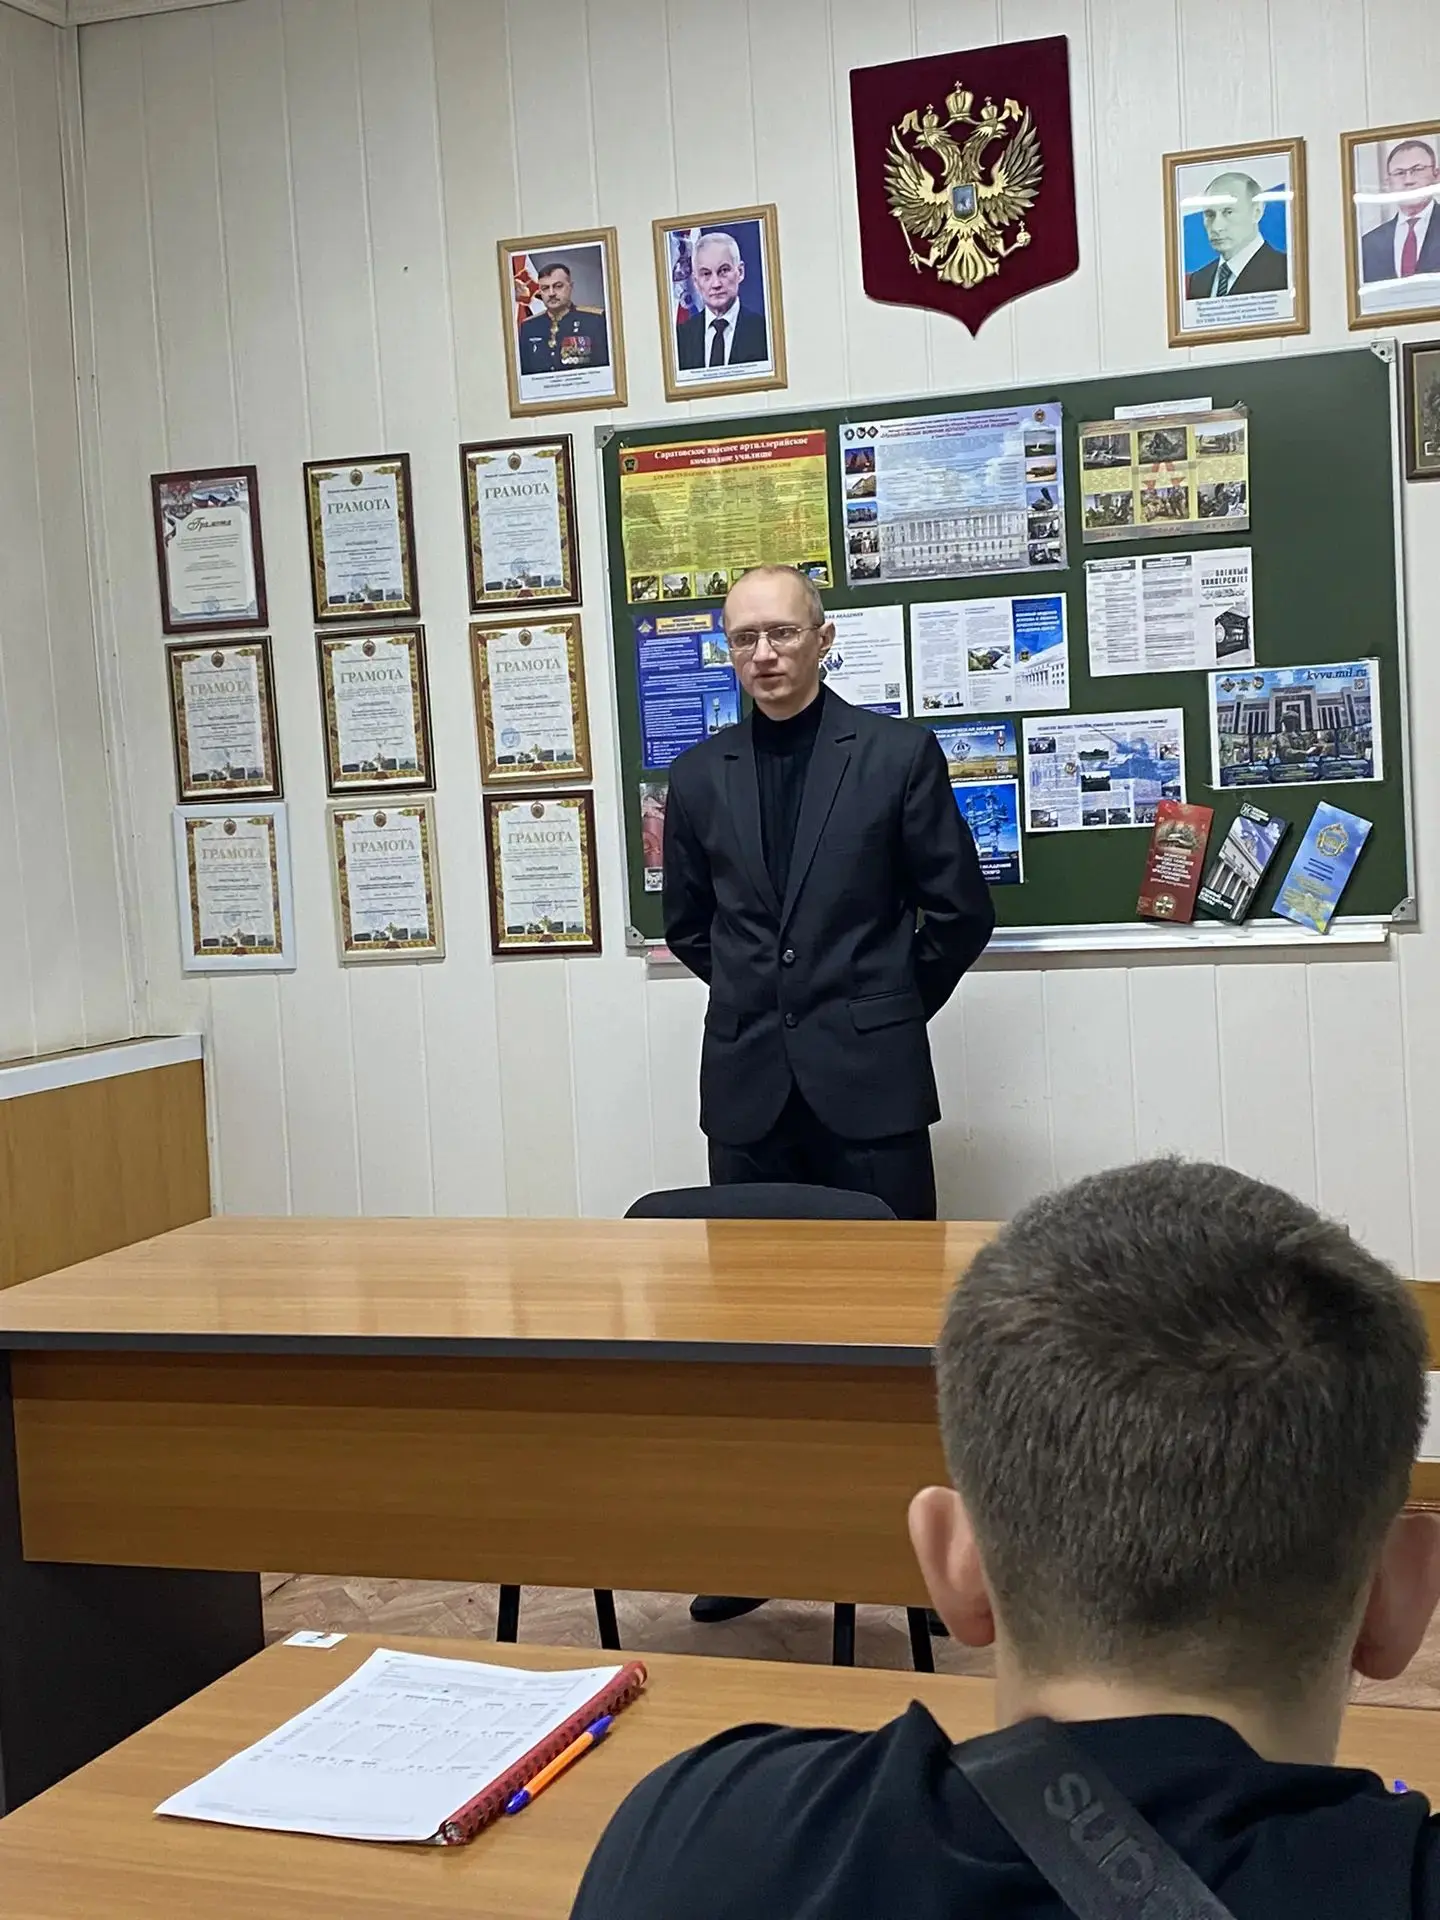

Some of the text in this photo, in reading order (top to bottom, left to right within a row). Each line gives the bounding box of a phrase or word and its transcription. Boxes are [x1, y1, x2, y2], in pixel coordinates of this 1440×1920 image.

[485, 482, 550, 499] ГРАМОТА
[328, 498, 391, 515] ГРАМОТА
[496, 658, 561, 673] ГРАМОТА
[340, 669, 403, 684] ГРАМОТА
[190, 681, 251, 695] ГРАМОТА
[508, 831, 574, 845] ГРАМОТА
[351, 839, 415, 853] ГРАМОТА
[202, 848, 264, 860] ГРАМОТА
